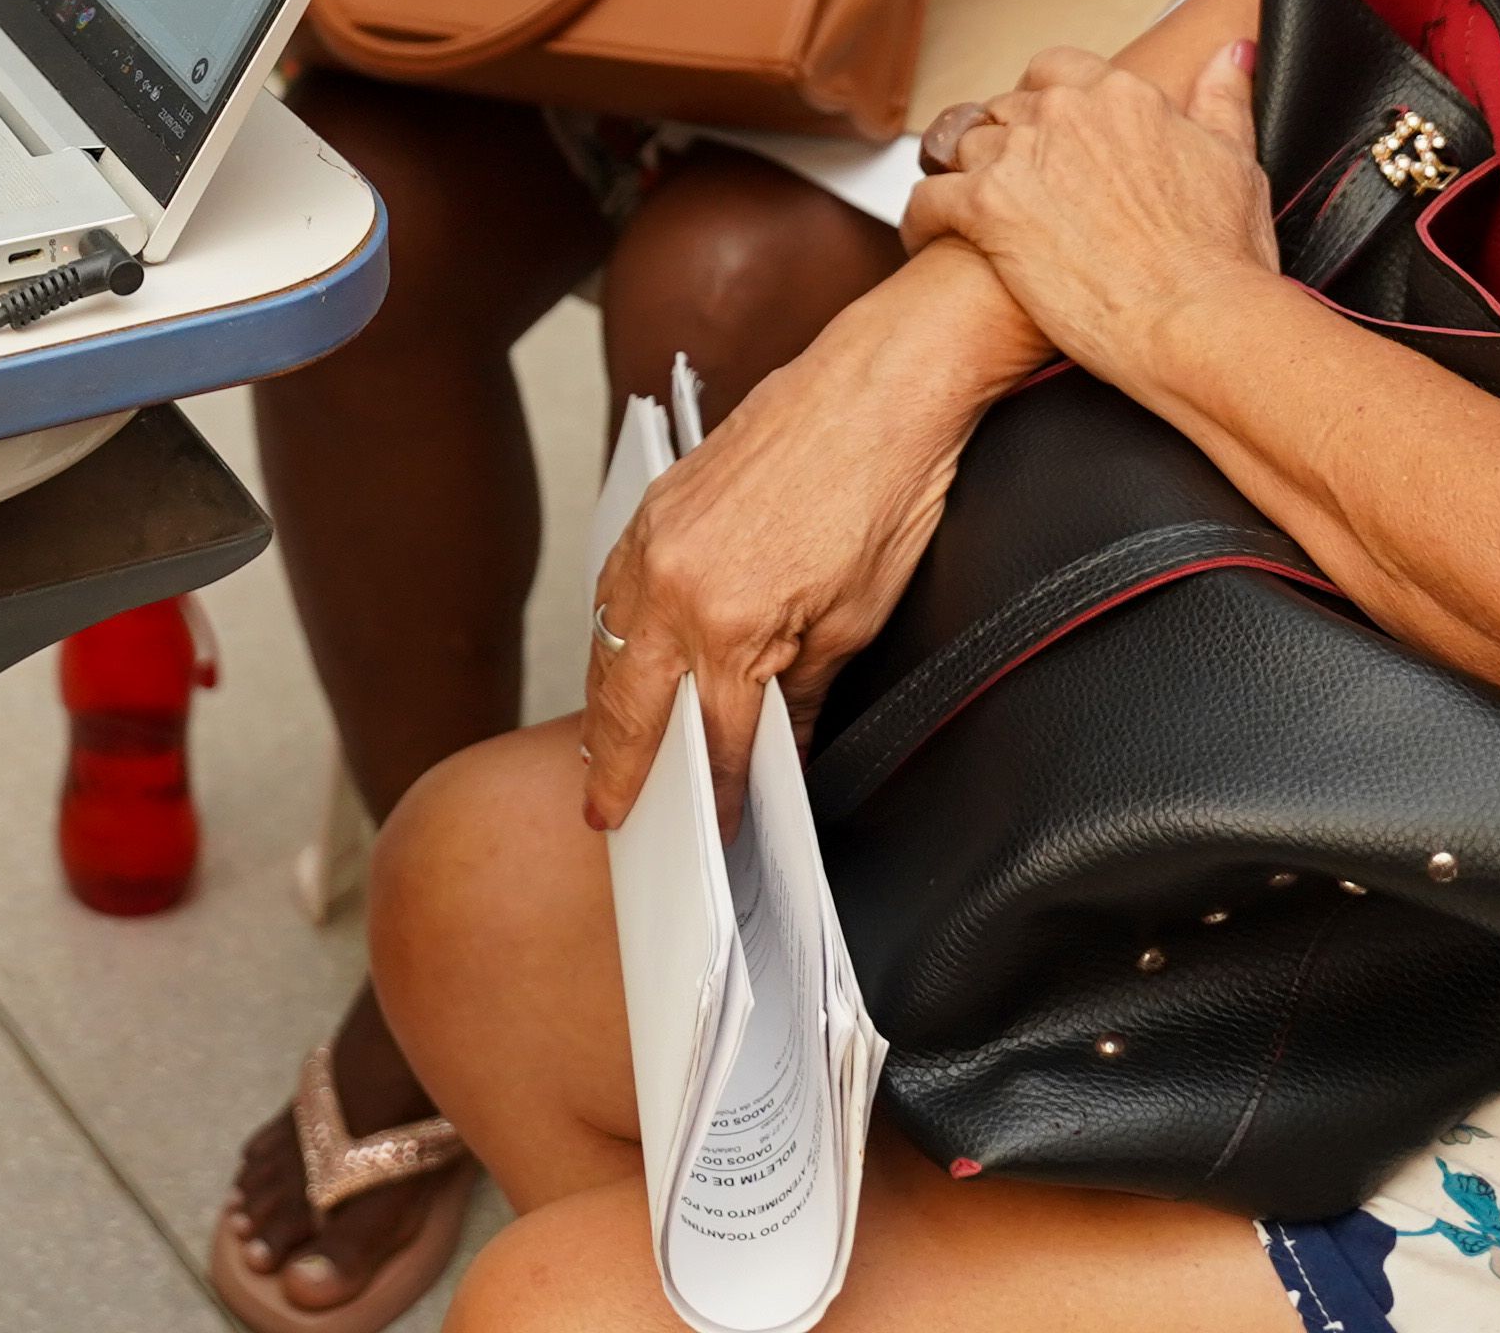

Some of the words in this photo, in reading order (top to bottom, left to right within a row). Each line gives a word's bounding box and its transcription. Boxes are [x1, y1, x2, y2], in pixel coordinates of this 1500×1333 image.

[733, 1098, 775, 1126] DADOS
[711, 1119, 729, 1128] DA
[702, 1156, 723, 1167] DO
[727, 1143, 773, 1166] DADOS
[740, 1140, 798, 1184] BOLETIM
[712, 1175, 736, 1187] DE
[727, 1167, 806, 1219] ATENDIMENTO
[703, 1206, 724, 1218] DA
[680, 1213, 757, 1241] TOCANTINS
[760, 1222, 780, 1237] DO
